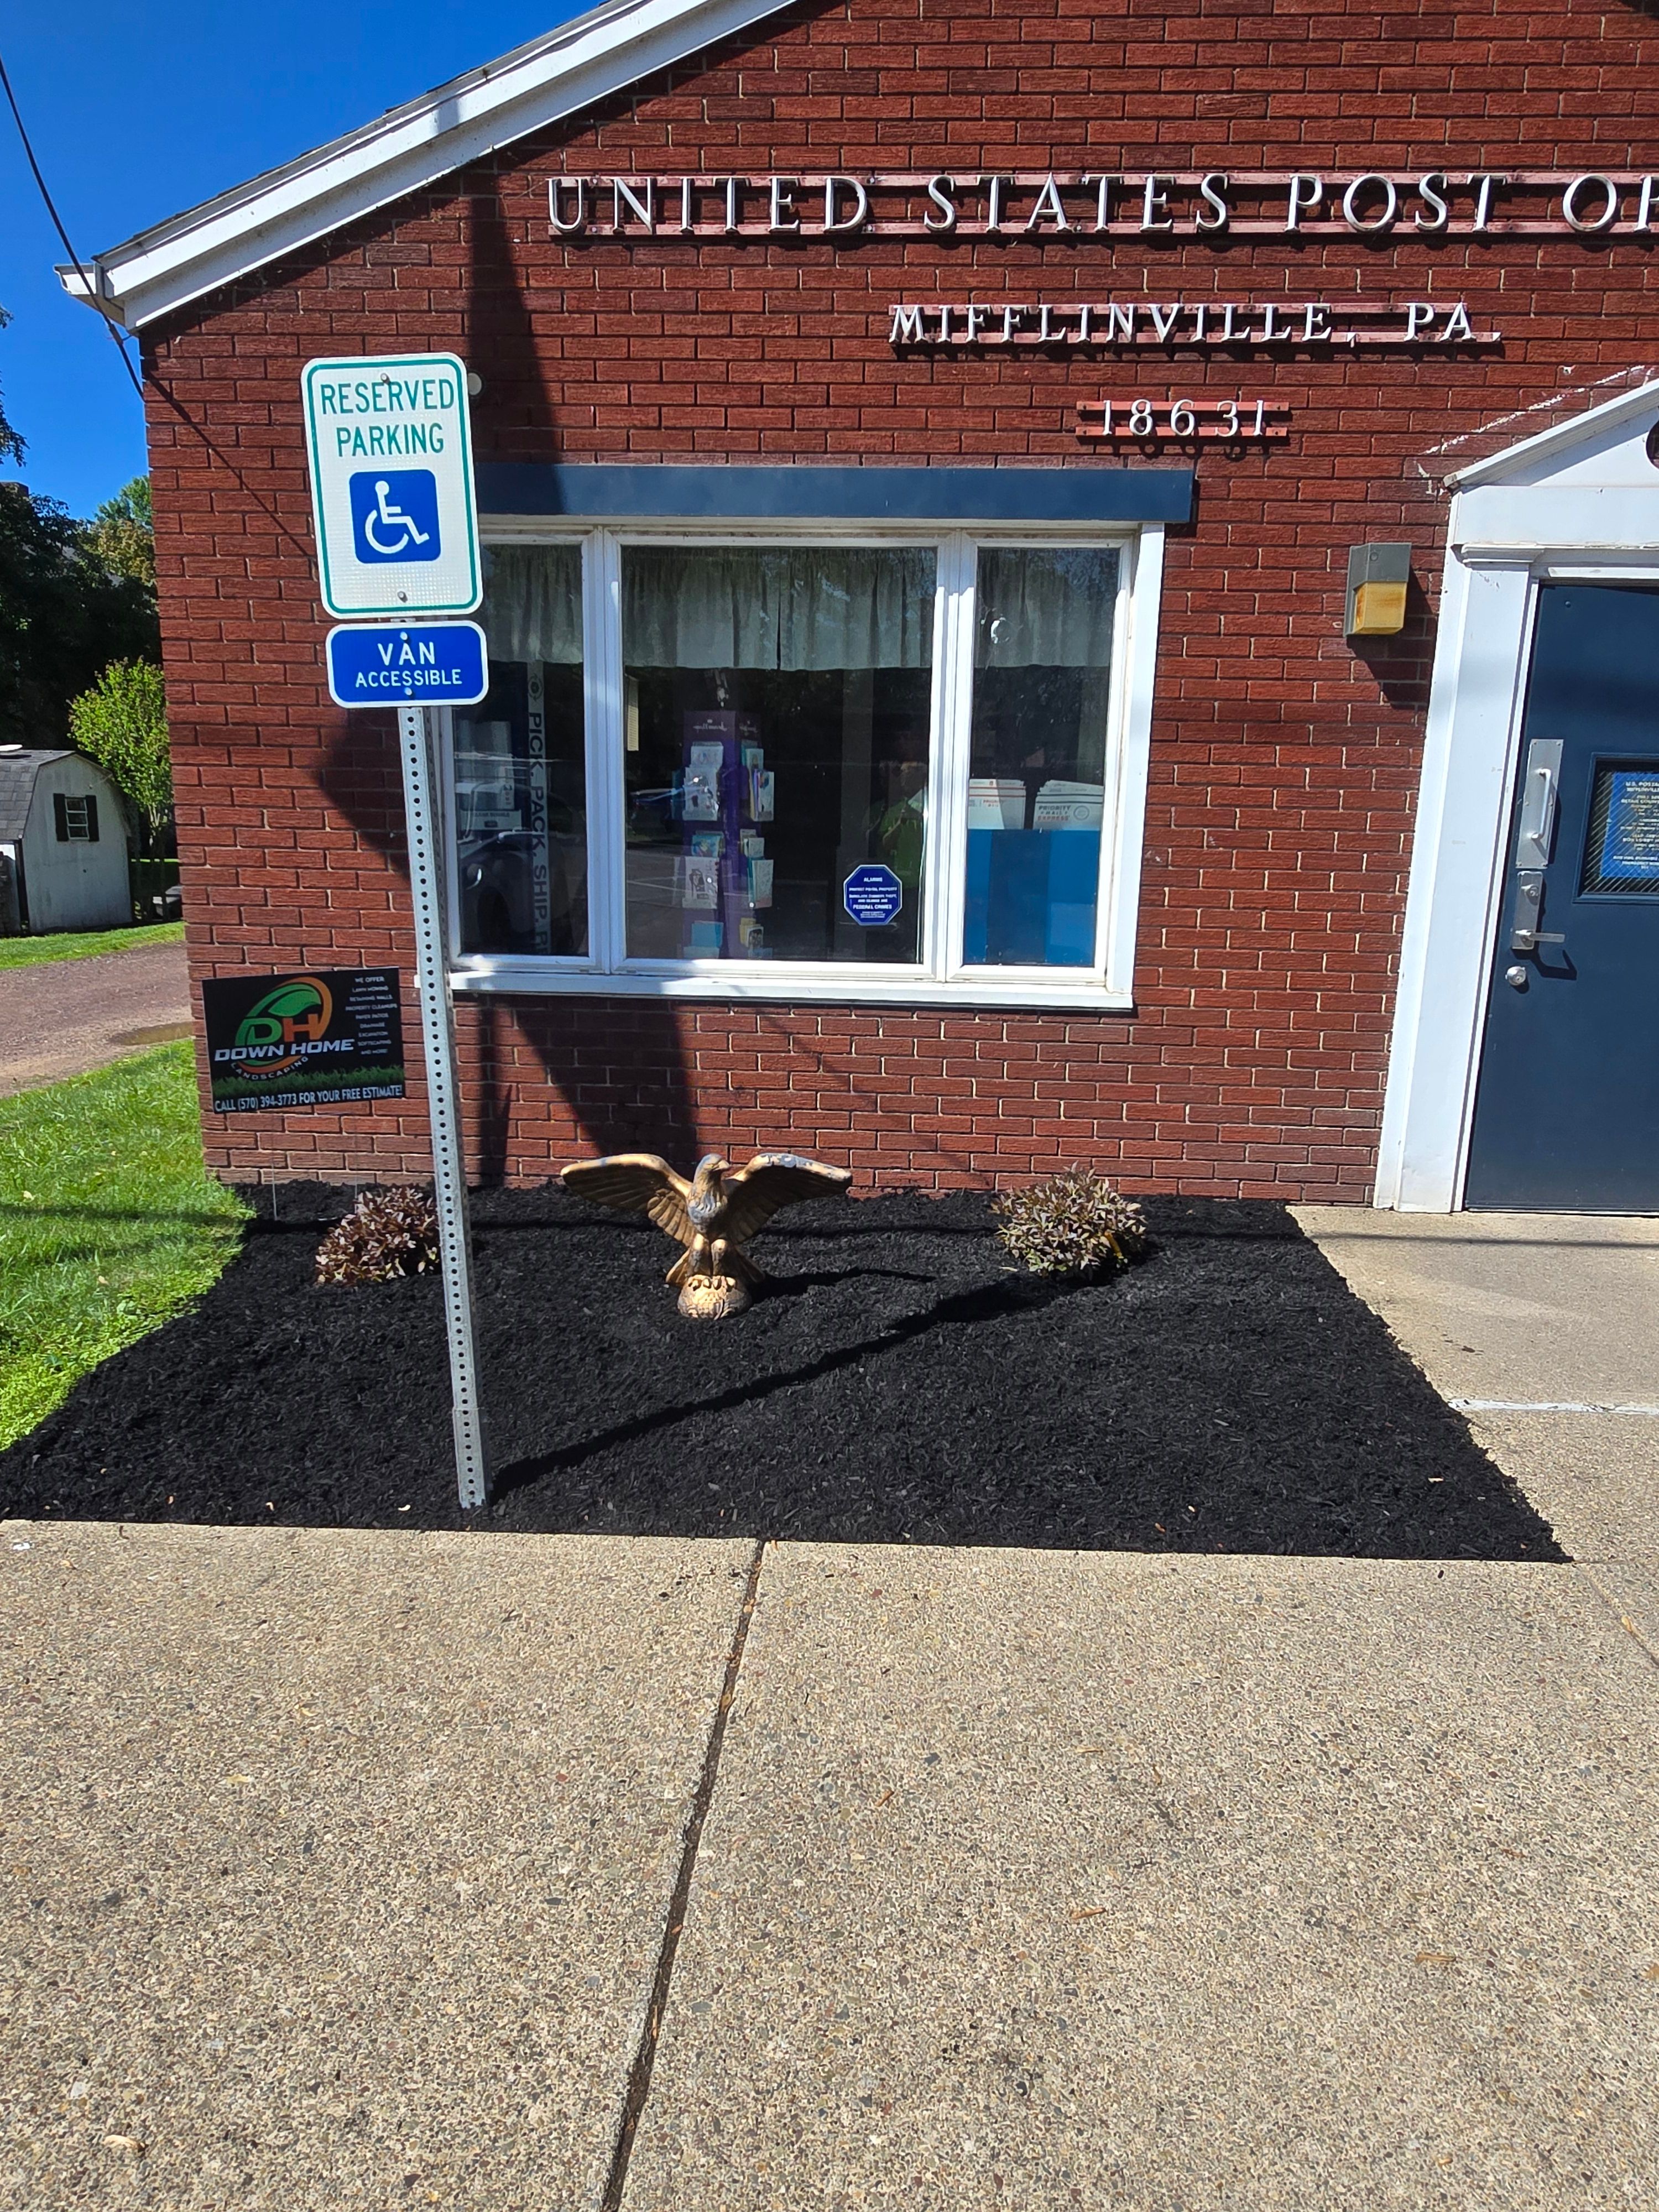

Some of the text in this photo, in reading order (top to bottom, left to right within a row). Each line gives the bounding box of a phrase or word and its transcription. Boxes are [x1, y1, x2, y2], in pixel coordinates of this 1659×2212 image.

[548, 176, 867, 233] UNITED
[924, 174, 1228, 232] STATES
[1285, 174, 1507, 232] POST
[889, 301, 1501, 348] MIFFLINVILLE, PA.
[321, 378, 455, 415] RESERVED
[1102, 399, 1264, 437] 18631
[336, 422, 444, 457] PARKING
[377, 640, 436, 666] VAN
[355, 669, 462, 688] ACCESSIBLE
[214, 1039, 355, 1061] DOWN HOME
[231, 1056, 309, 1079] LANDSCAPING
[214, 1084, 403, 1112] CALL (570) 394-3773 FOR YOUR FREE ESTIMATE!
